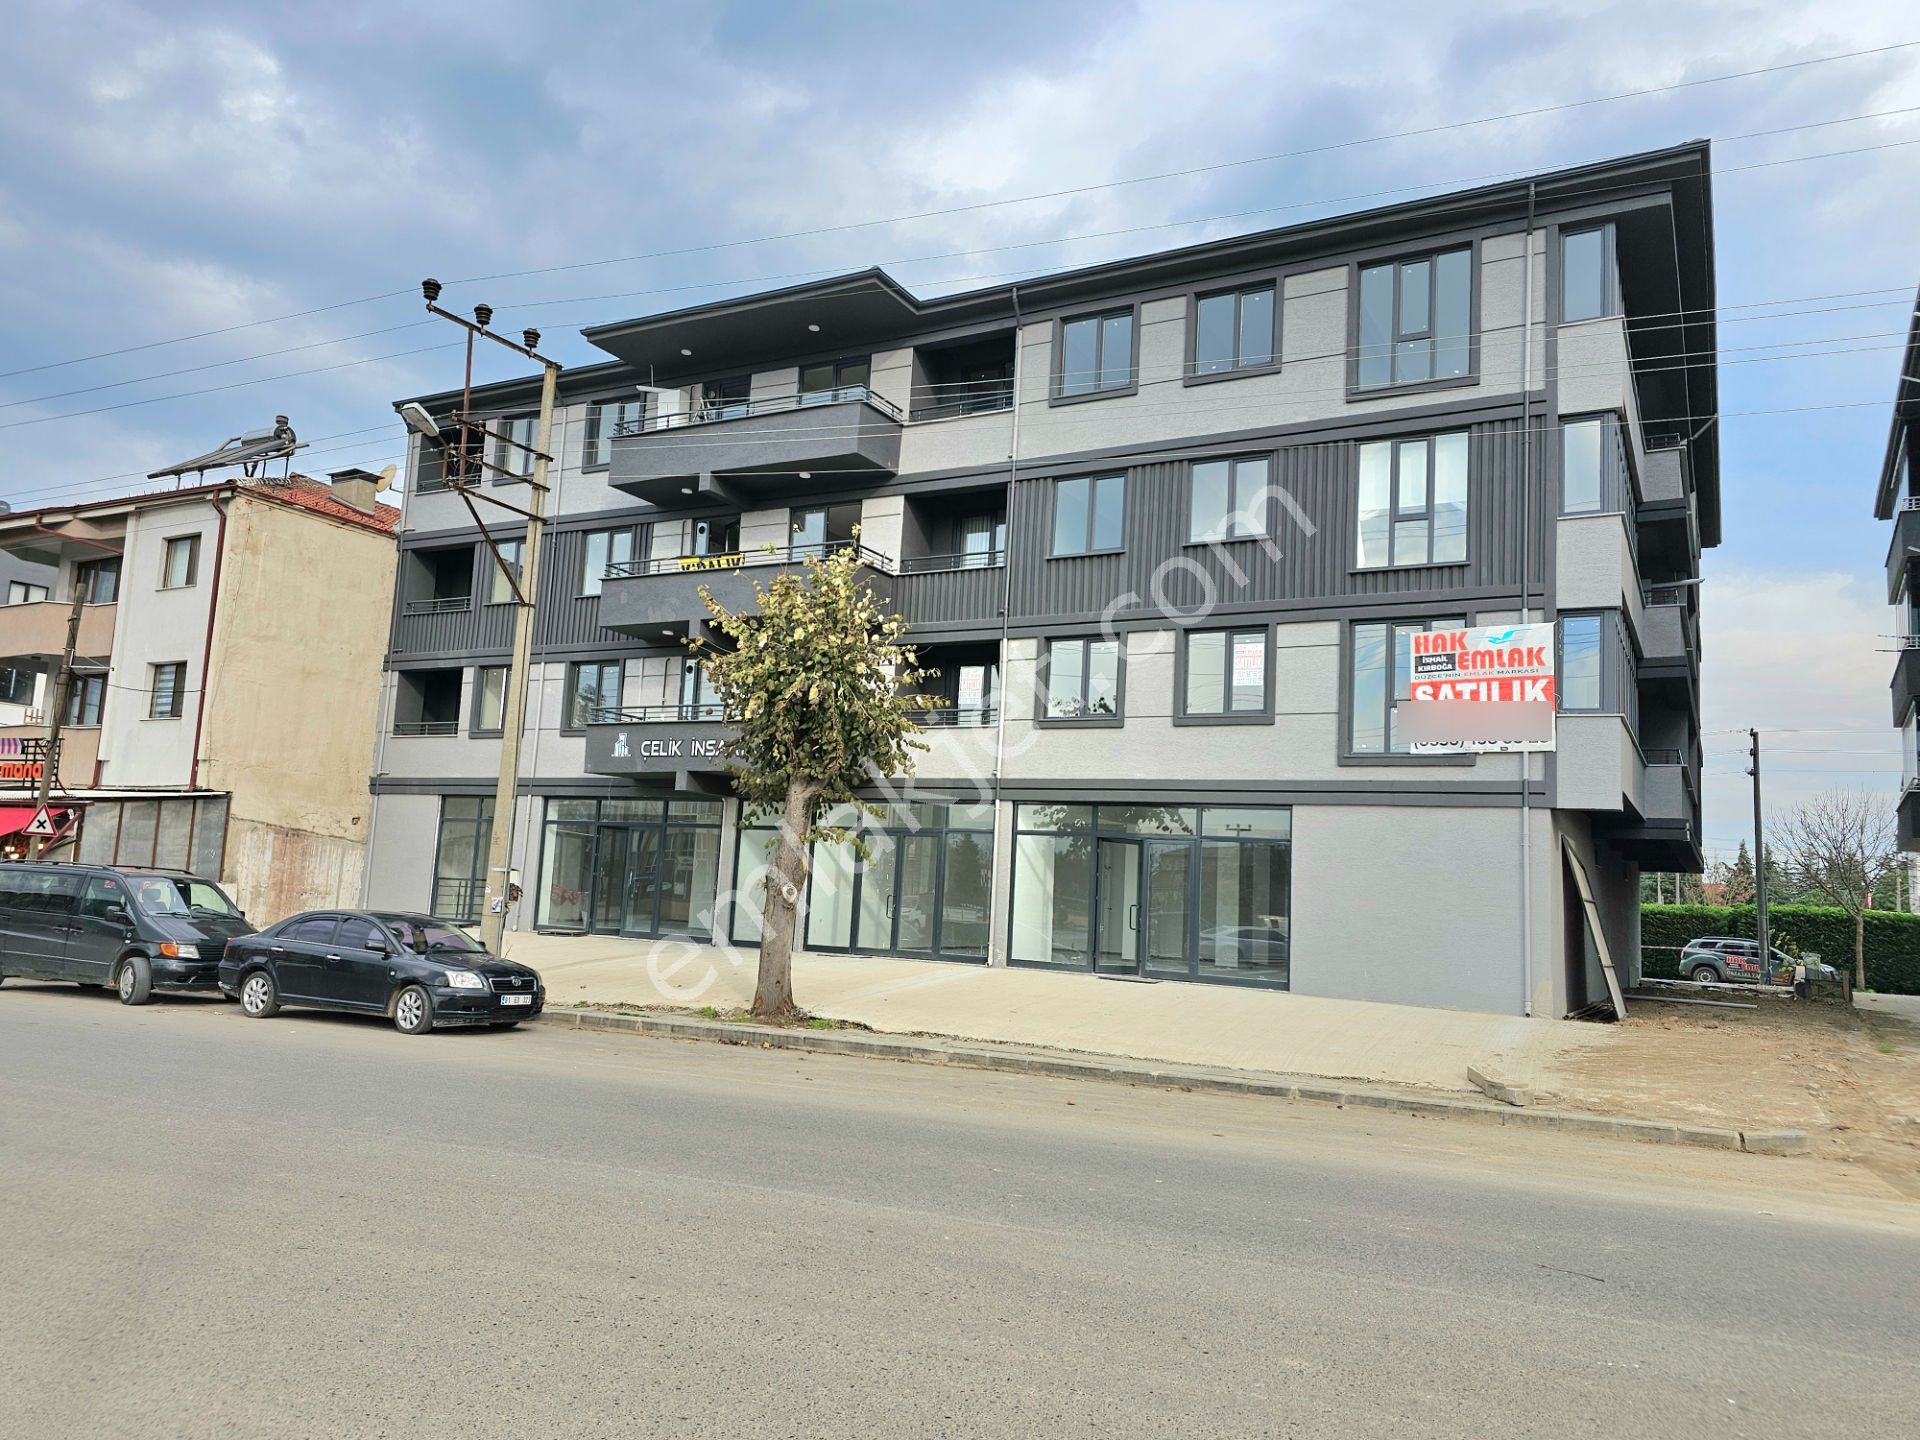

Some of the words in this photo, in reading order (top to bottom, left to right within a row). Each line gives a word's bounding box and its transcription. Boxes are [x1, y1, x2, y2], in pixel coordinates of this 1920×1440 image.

[1414, 632, 1467, 653] HAK
[1458, 647, 1546, 670] EMLAK
[1415, 679, 1549, 702] SATILIK
[641, 737, 682, 761] ÇELİK
